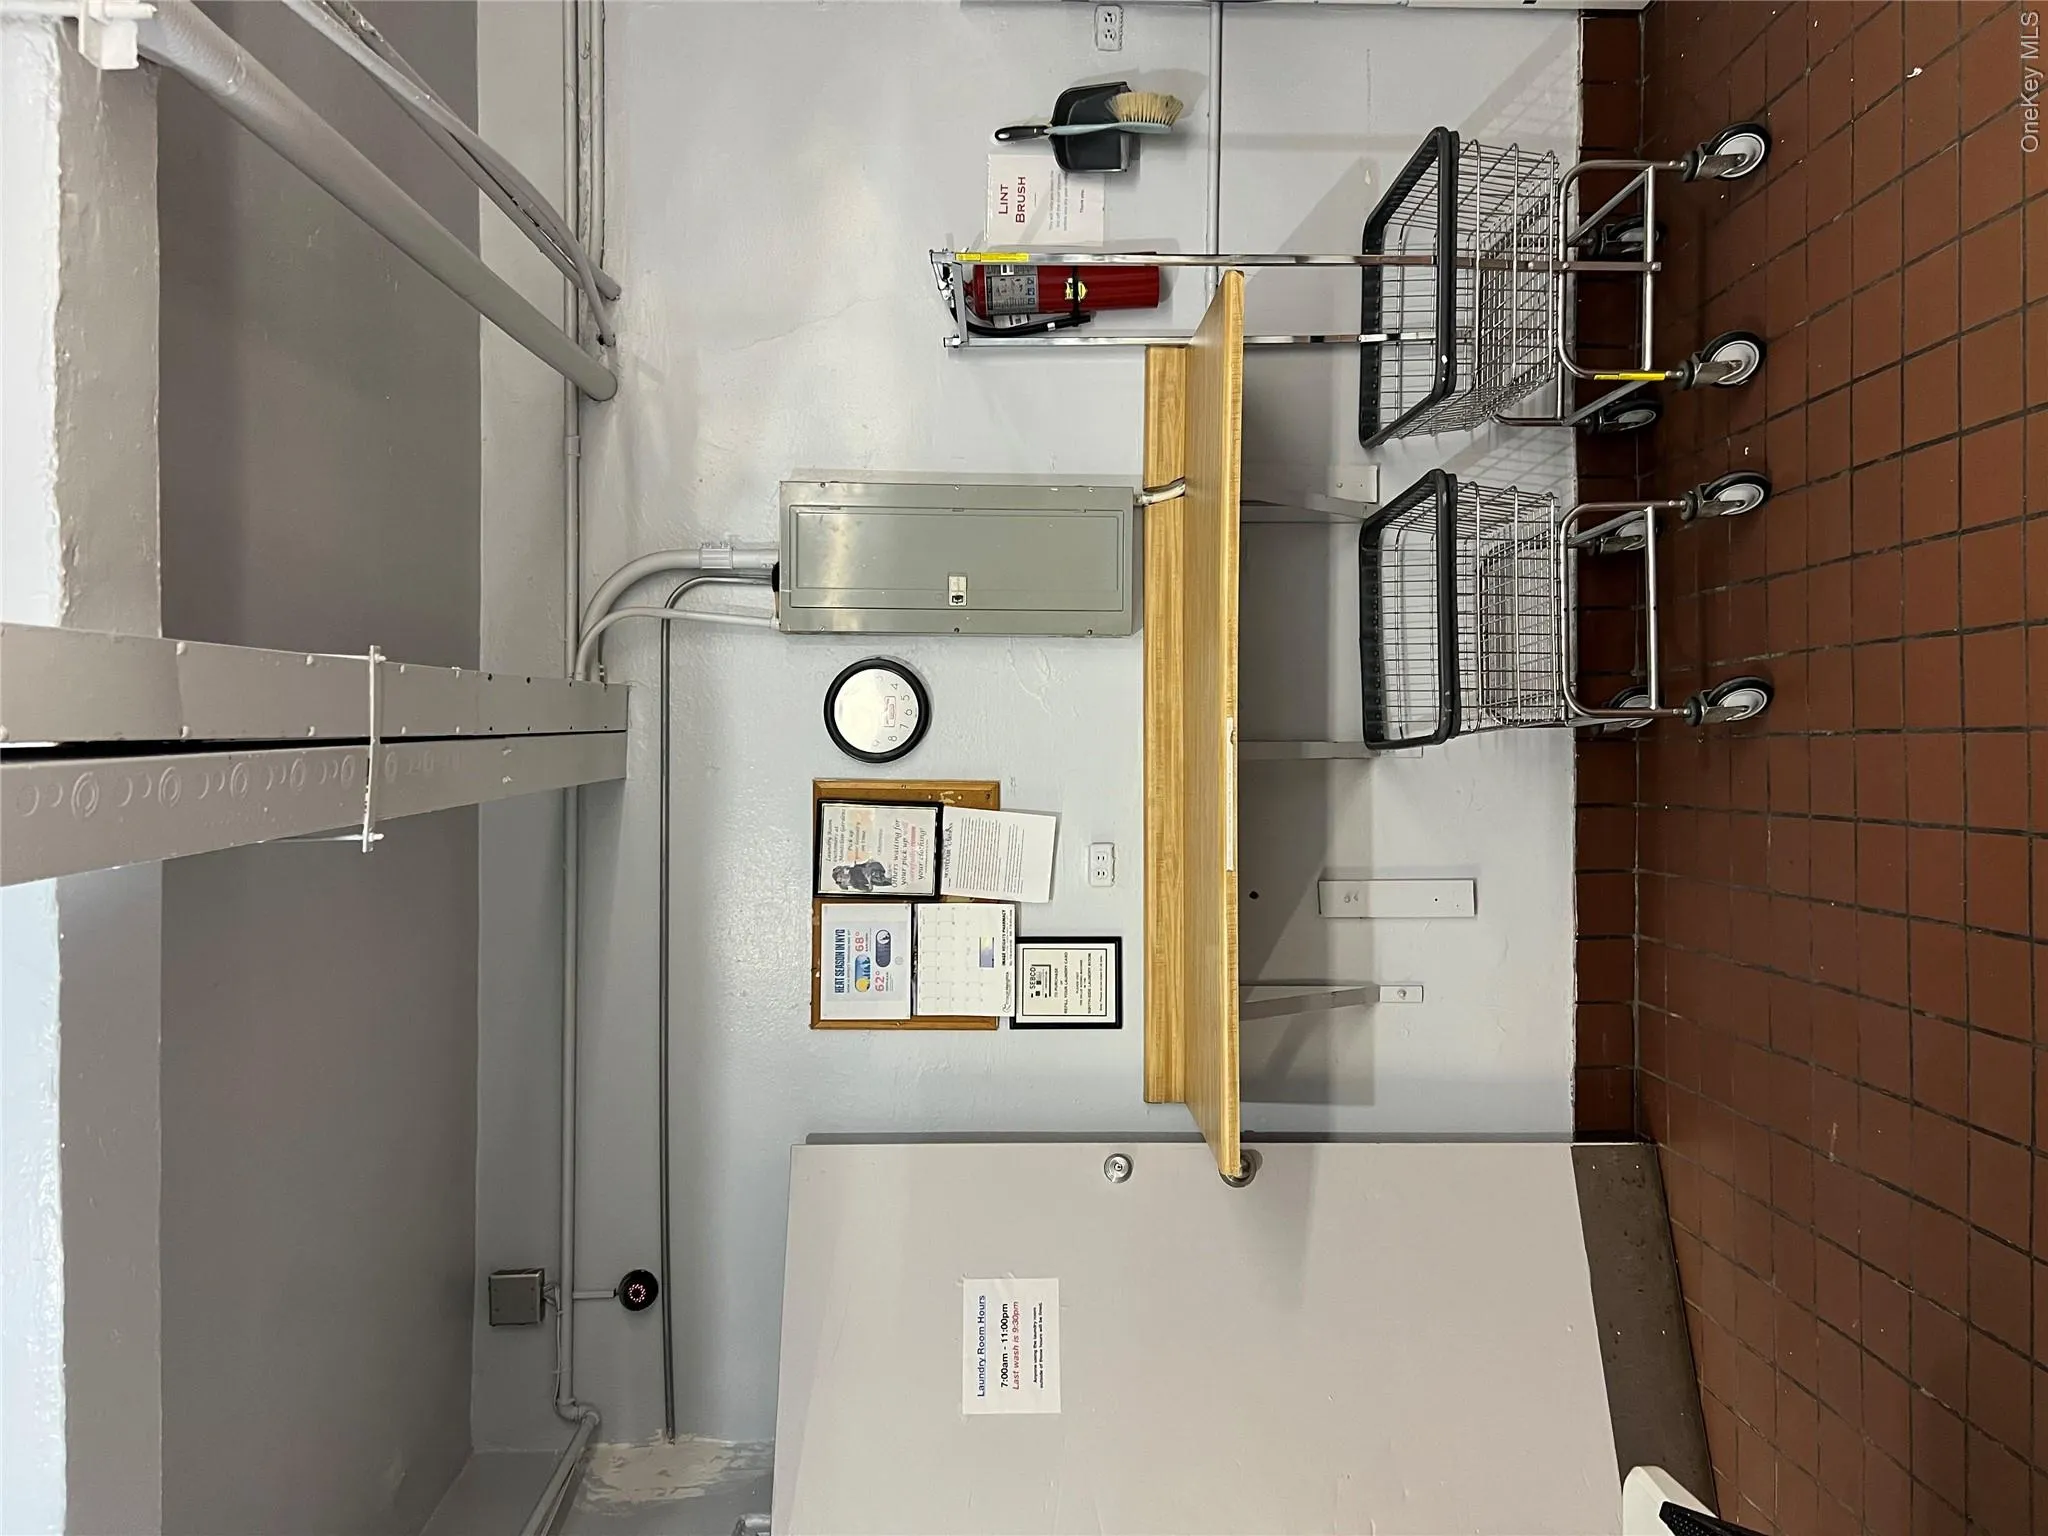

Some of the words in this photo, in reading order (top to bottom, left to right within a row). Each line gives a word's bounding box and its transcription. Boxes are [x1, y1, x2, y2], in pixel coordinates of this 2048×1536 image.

[998, 184, 1008, 214] LINT
[1016, 176, 1026, 223] BRUSH
[834, 952, 846, 976] SEASON
[834, 978, 845, 993] HEAT
[977, 1295, 985, 1324] Hours
[1000, 1304, 1009, 1343] 11:00pm
[1012, 1302, 1020, 1333] 9:30pm
[977, 1326, 985, 1354] Room
[977, 1358, 986, 1397] Laundry
[1000, 1353, 1008, 1388] 7:00am
